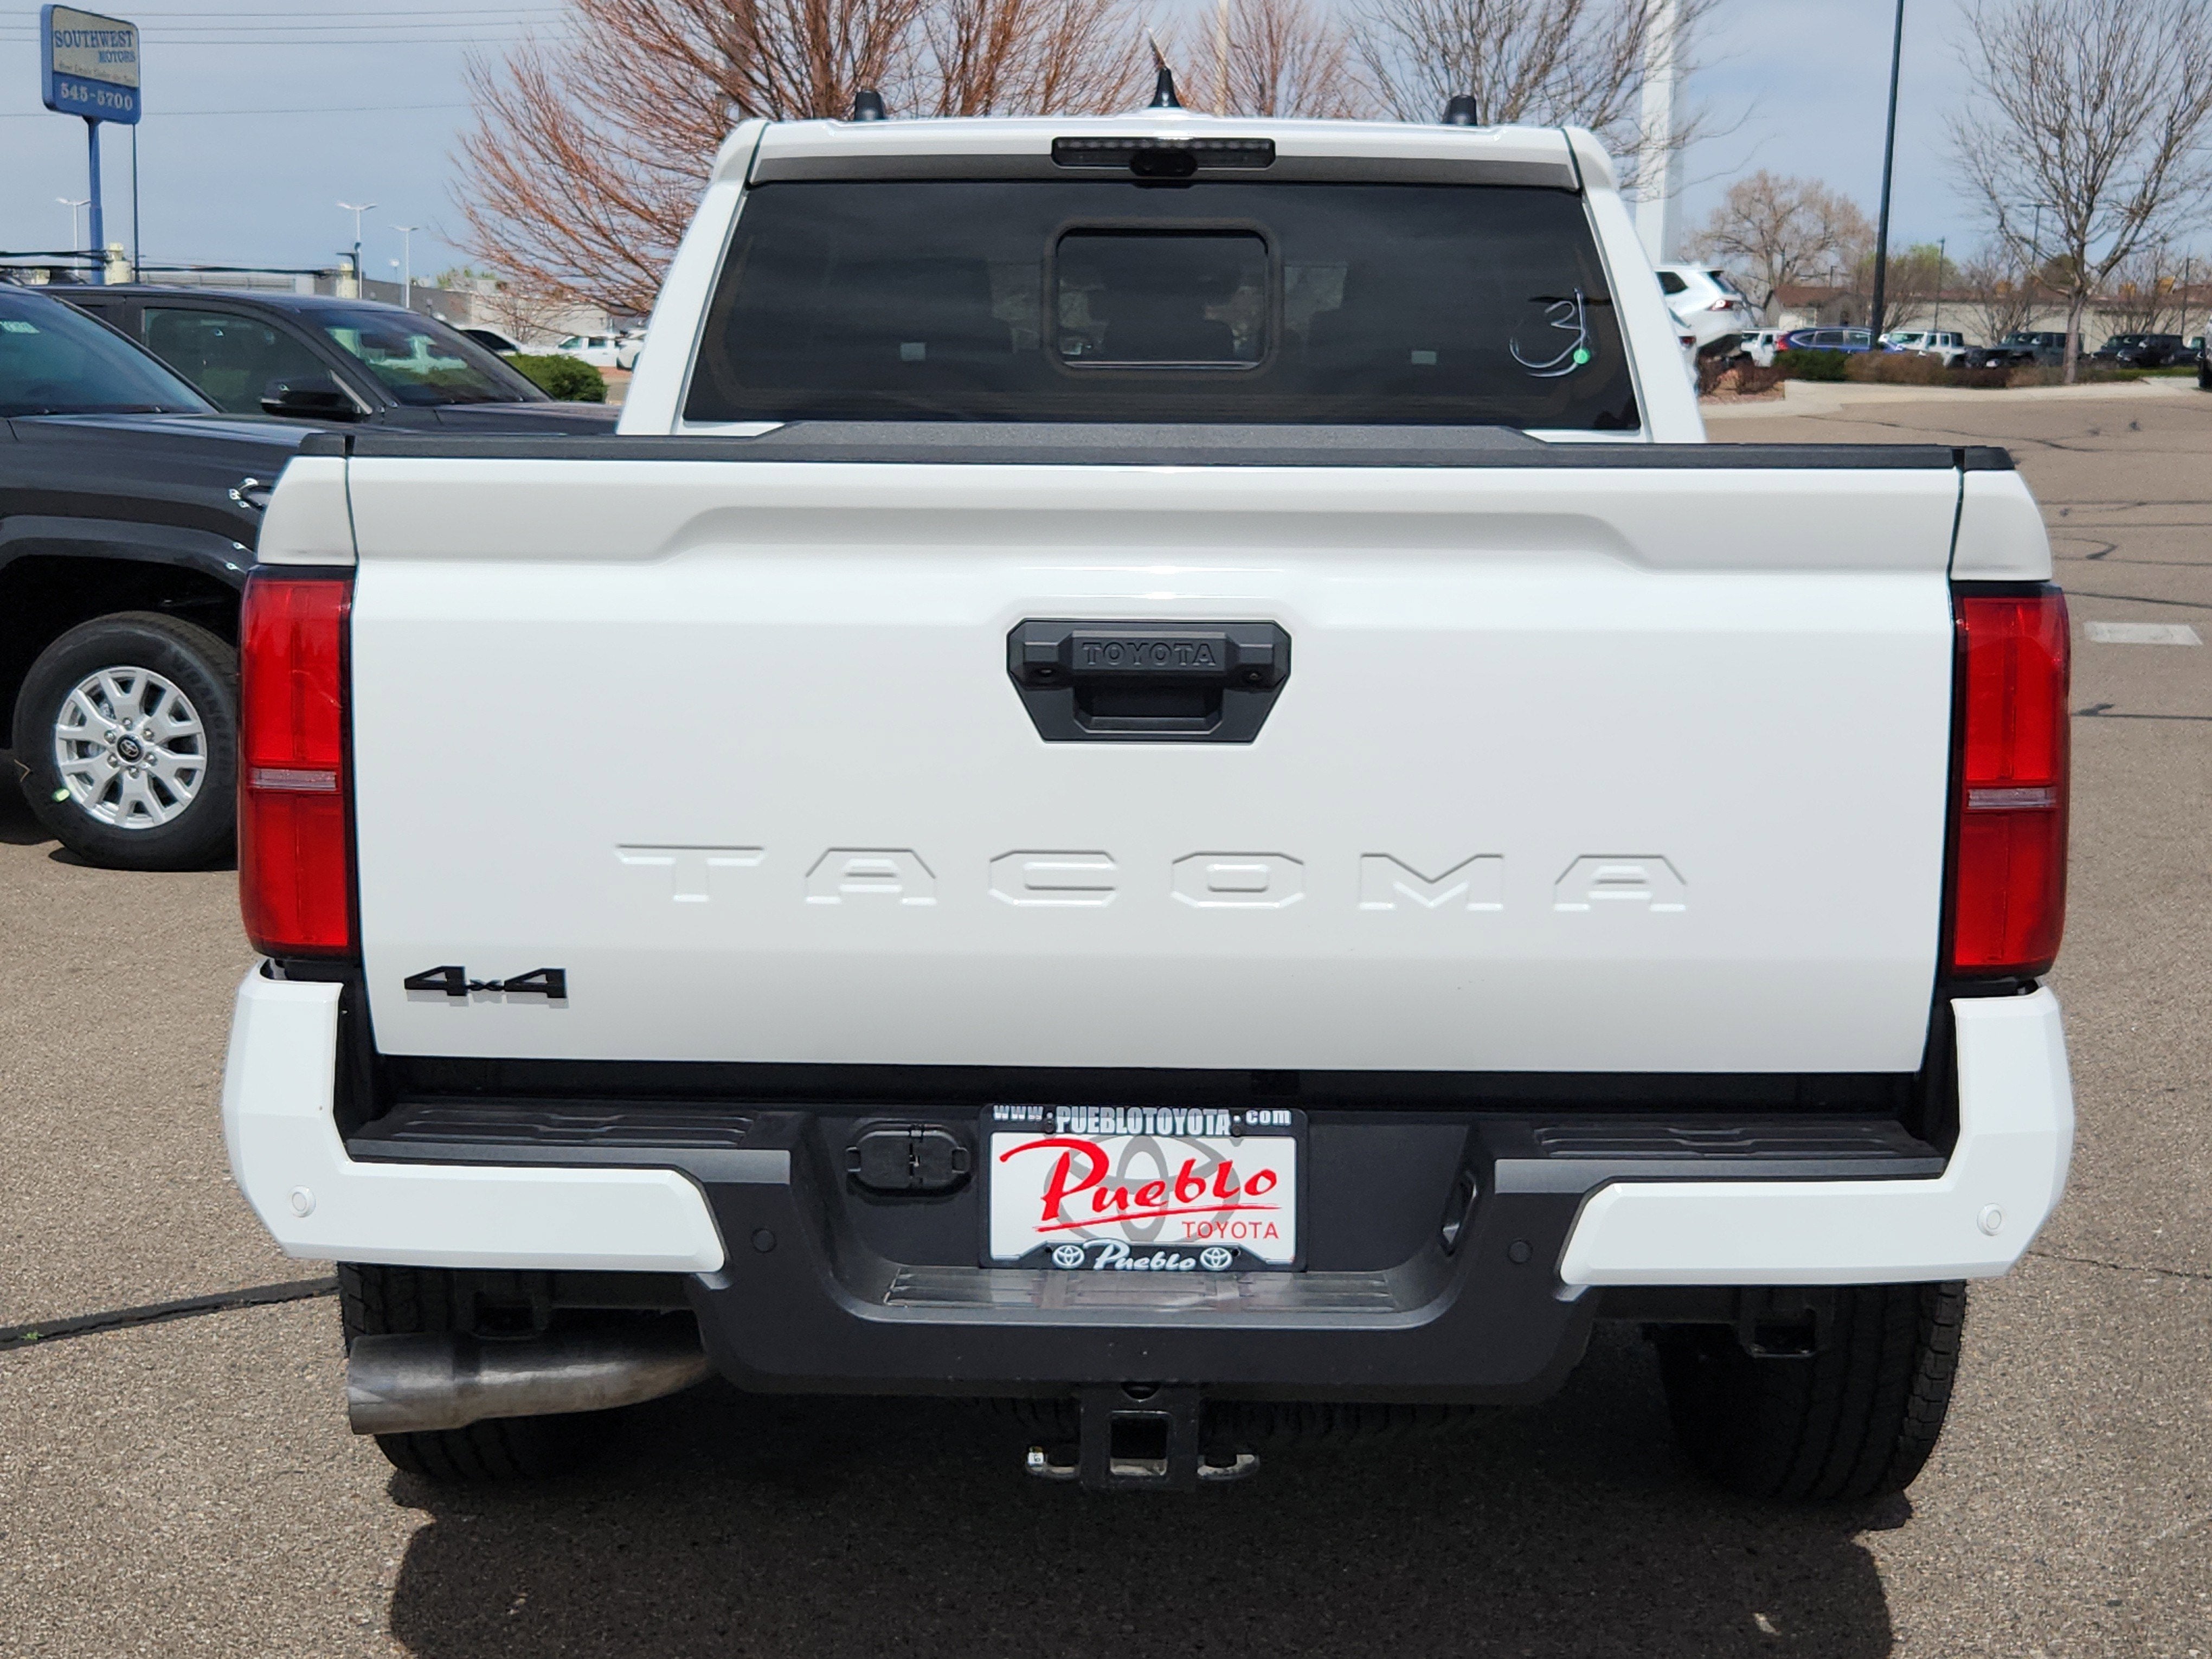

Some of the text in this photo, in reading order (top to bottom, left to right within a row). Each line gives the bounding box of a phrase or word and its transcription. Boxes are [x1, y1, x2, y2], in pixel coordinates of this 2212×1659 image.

[55, 30, 133, 48] SOUTHWEST
[98, 50, 136, 63] MOTORS
[61, 82, 133, 111] 545-5700
[1082, 641, 1216, 667] TOYOTA
[615, 844, 1687, 911] TACOMA
[404, 965, 567, 999] 4x4
[999, 1137, 1277, 1221] Pueblo
[1182, 1221, 1279, 1239] TOYOTA
[1083, 1238, 1196, 1271] Pueblo
